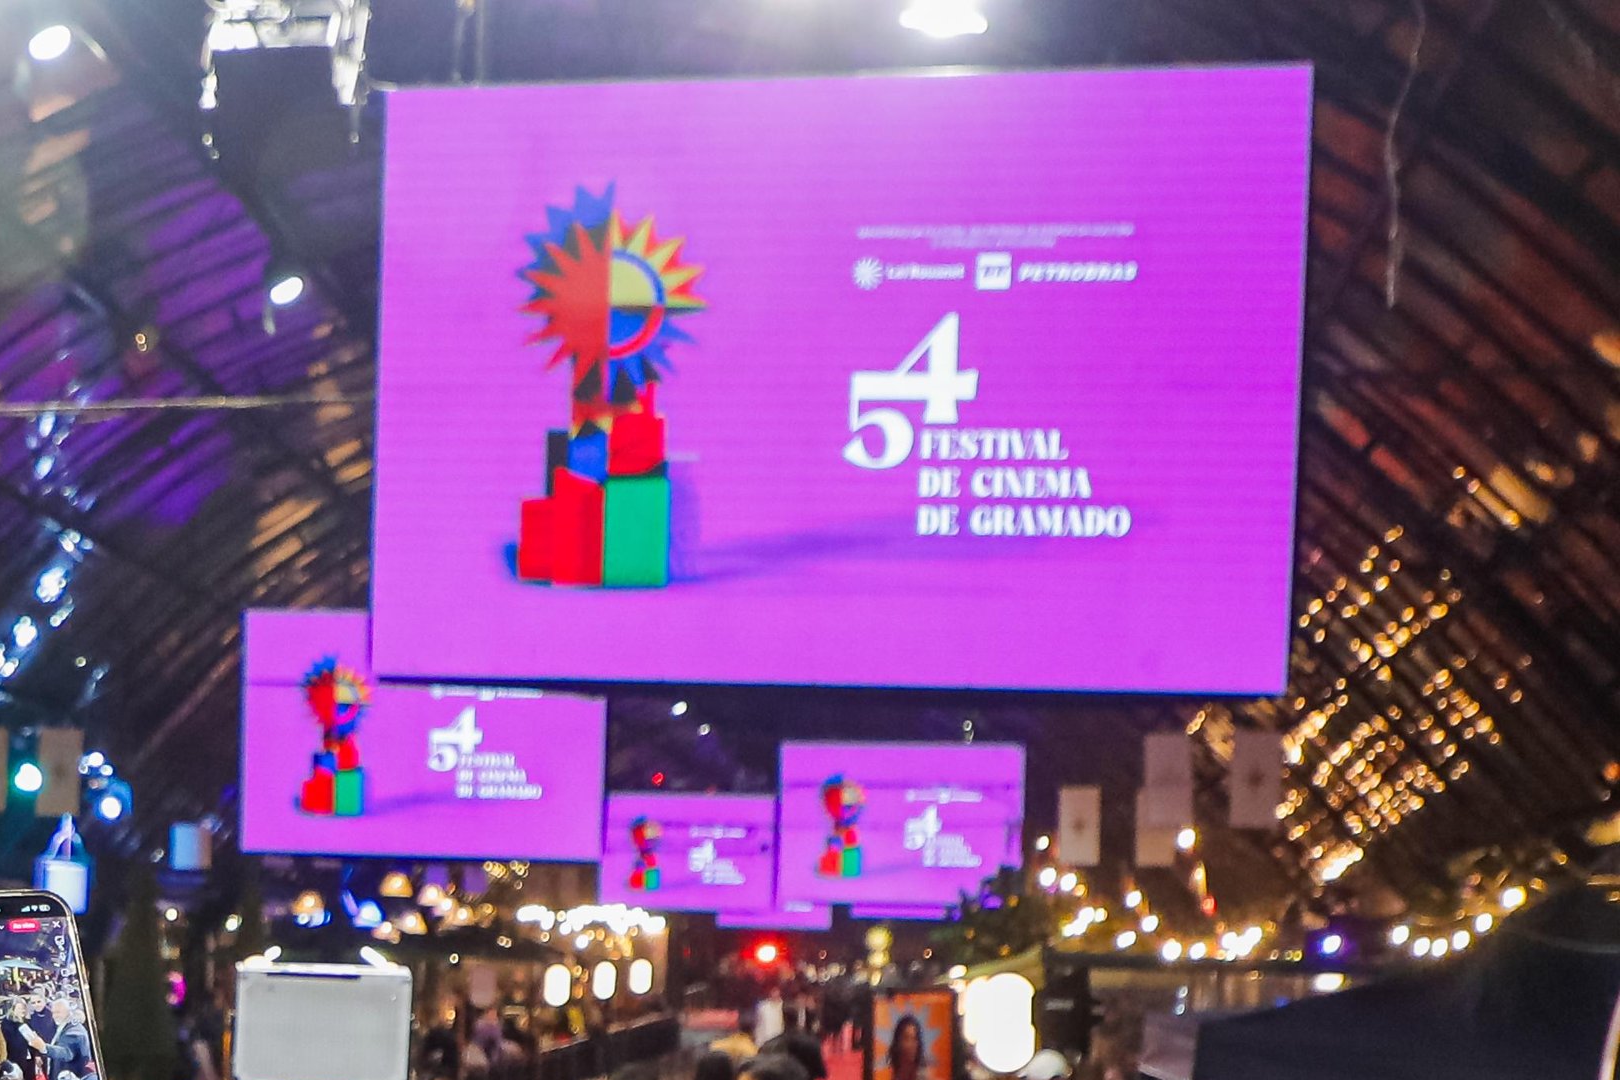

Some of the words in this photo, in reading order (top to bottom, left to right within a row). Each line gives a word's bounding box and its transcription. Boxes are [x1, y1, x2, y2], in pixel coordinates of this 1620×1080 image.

[1018, 262, 1138, 282] PETROBRAS
[842, 311, 979, 470] 54
[919, 427, 1069, 461] FESTIVAL
[917, 465, 961, 499] DE
[970, 466, 1092, 500] CINEMA
[915, 503, 960, 537] DE
[969, 504, 1133, 538] GRAMADO
